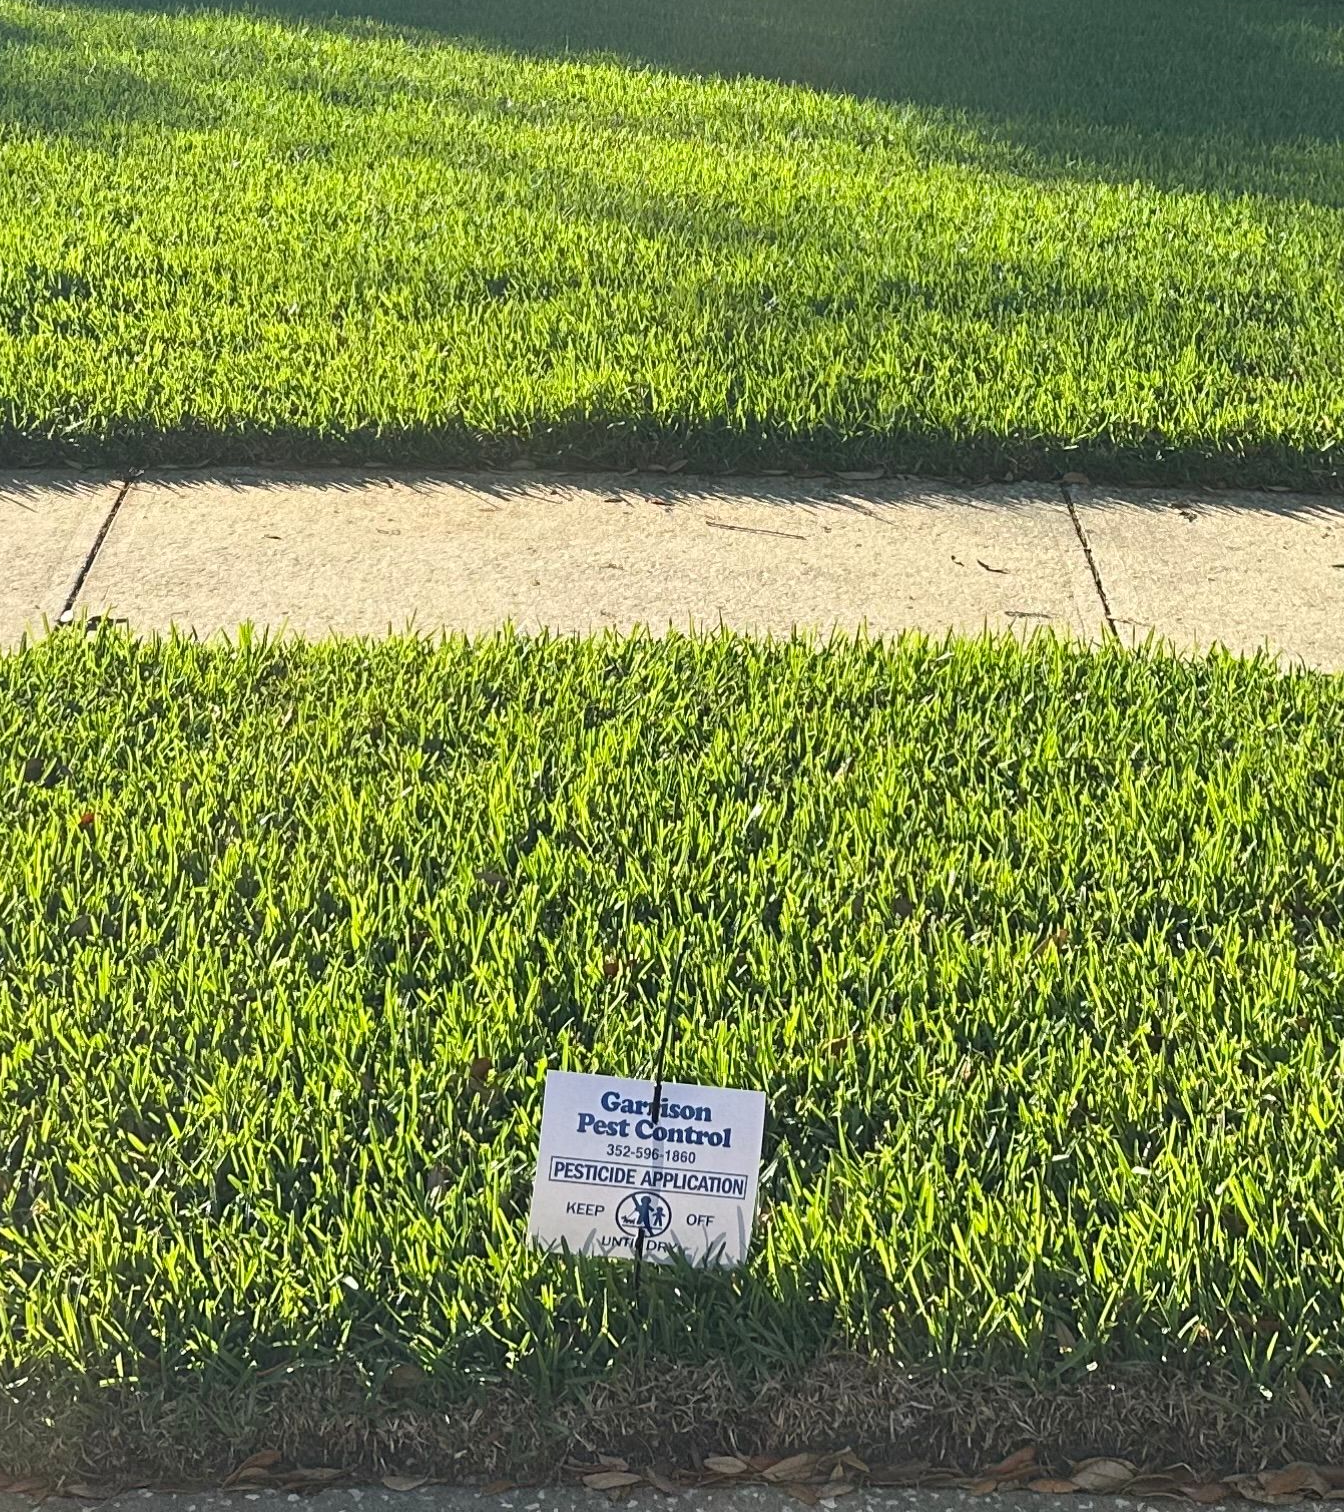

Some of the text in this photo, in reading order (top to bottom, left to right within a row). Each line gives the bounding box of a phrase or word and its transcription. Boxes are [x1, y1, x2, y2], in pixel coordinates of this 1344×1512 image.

[577, 1113, 731, 1148] Pest Control
[606, 1143, 696, 1164] 352-596-1860
[553, 1161, 744, 1196] PESTICIDE APPLICATION
[566, 1201, 715, 1227] KEEP OFF
[602, 1235, 640, 1248] UNTI
